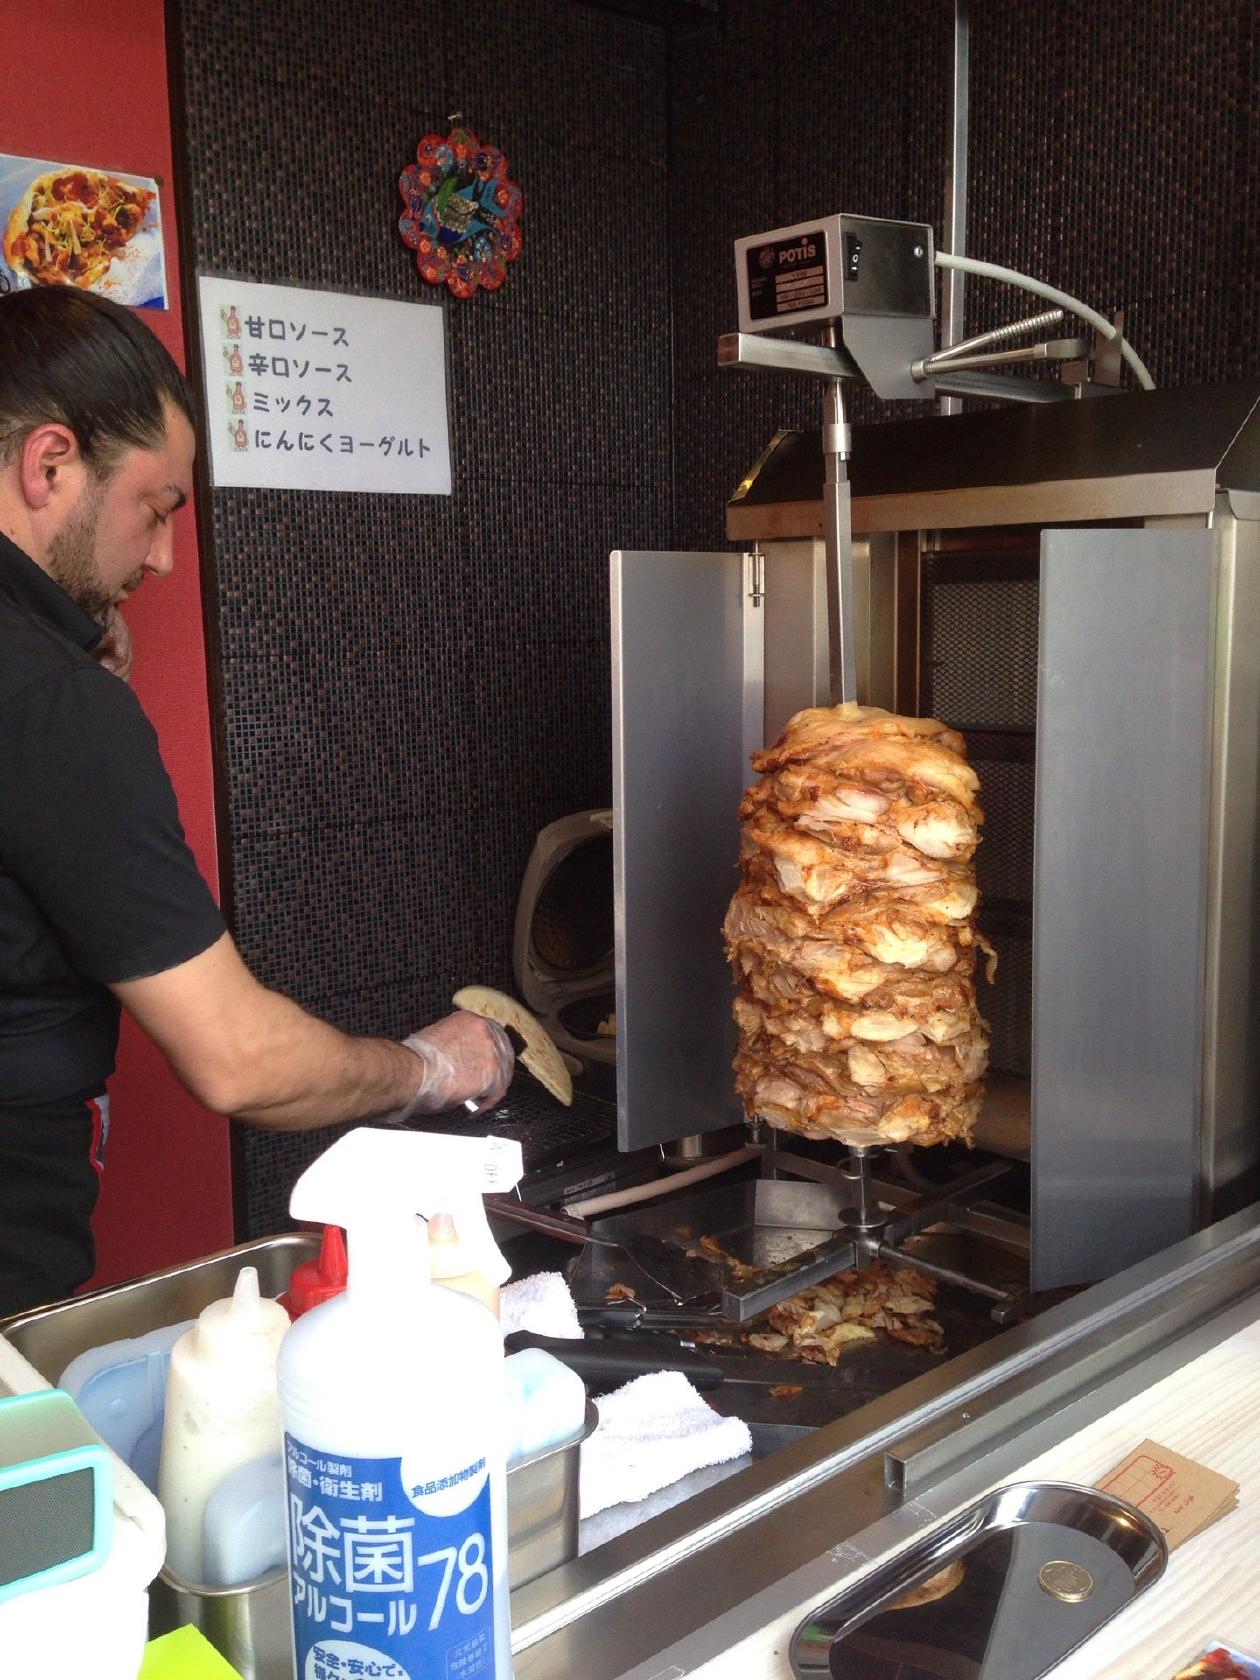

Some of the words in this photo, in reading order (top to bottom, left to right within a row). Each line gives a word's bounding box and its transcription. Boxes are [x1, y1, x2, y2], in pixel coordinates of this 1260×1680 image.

[244, 316, 349, 347] 甘口ソース
[248, 353, 352, 383] 辛口ソース
[253, 391, 334, 417] ミックス
[255, 429, 431, 459] にんにくヨーグルト
[290, 1493, 415, 1594] 除菌
[417, 1532, 489, 1632] 78
[293, 1572, 417, 1638] アルコール
